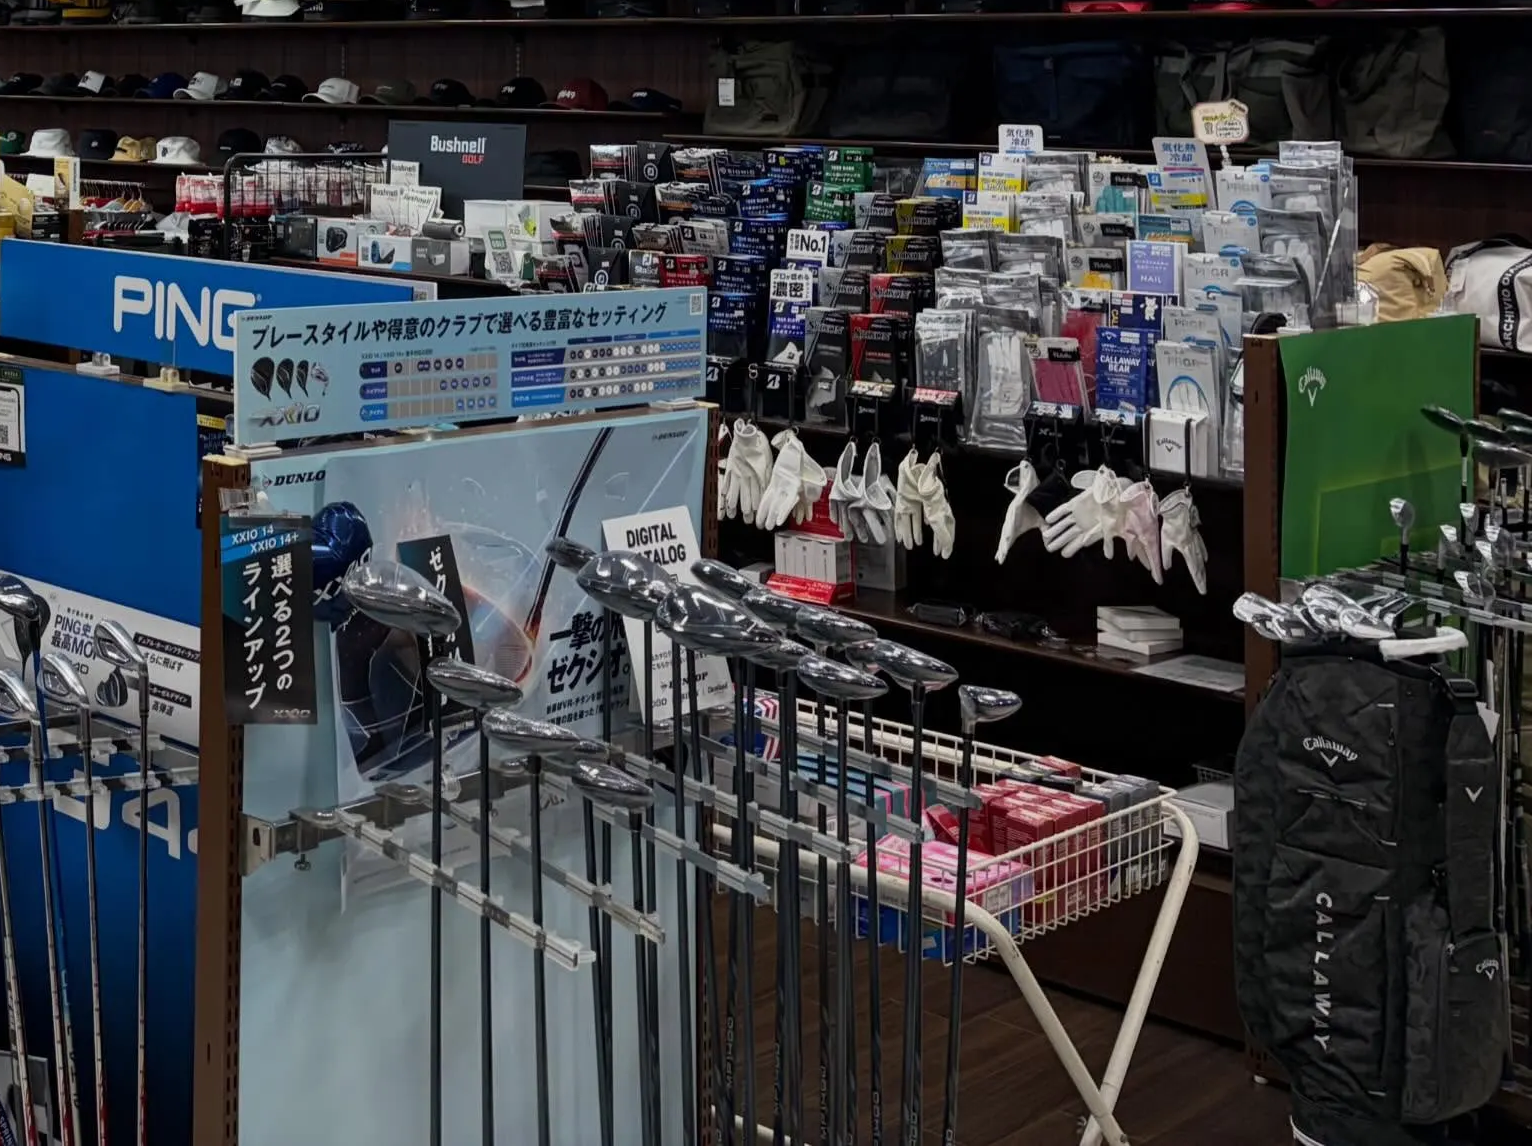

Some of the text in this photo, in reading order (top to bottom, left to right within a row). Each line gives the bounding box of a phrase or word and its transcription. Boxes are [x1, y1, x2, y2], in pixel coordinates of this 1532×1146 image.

[1006, 128, 1034, 138] 気化熱
[1011, 137, 1030, 146] 冷却
[430, 135, 487, 154] Bushnell
[1161, 143, 1196, 153] 気化熱
[461, 154, 484, 164] GOLF
[1169, 154, 1193, 162] 冷却
[800, 235, 826, 254] No.1
[1140, 276, 1162, 284] NAIL
[113, 275, 255, 352] PING
[1100, 355, 1141, 366] CALLAWAY
[1108, 365, 1130, 373] BEAR
[1298, 366, 1327, 394] Callaway
[274, 470, 326, 486] DUNLO
[231, 524, 274, 545] XXIO 14
[250, 532, 299, 554] XXIO 14+
[626, 522, 677, 548] DIGITAL
[54, 614, 94, 639] PING史
[271, 553, 295, 691] 選べる2つの
[51, 630, 96, 660] 最高MO
[242, 562, 267, 710] ラインアップ
[1303, 735, 1358, 762] Callaway
[1313, 891, 1334, 1052] CALLAWAY
